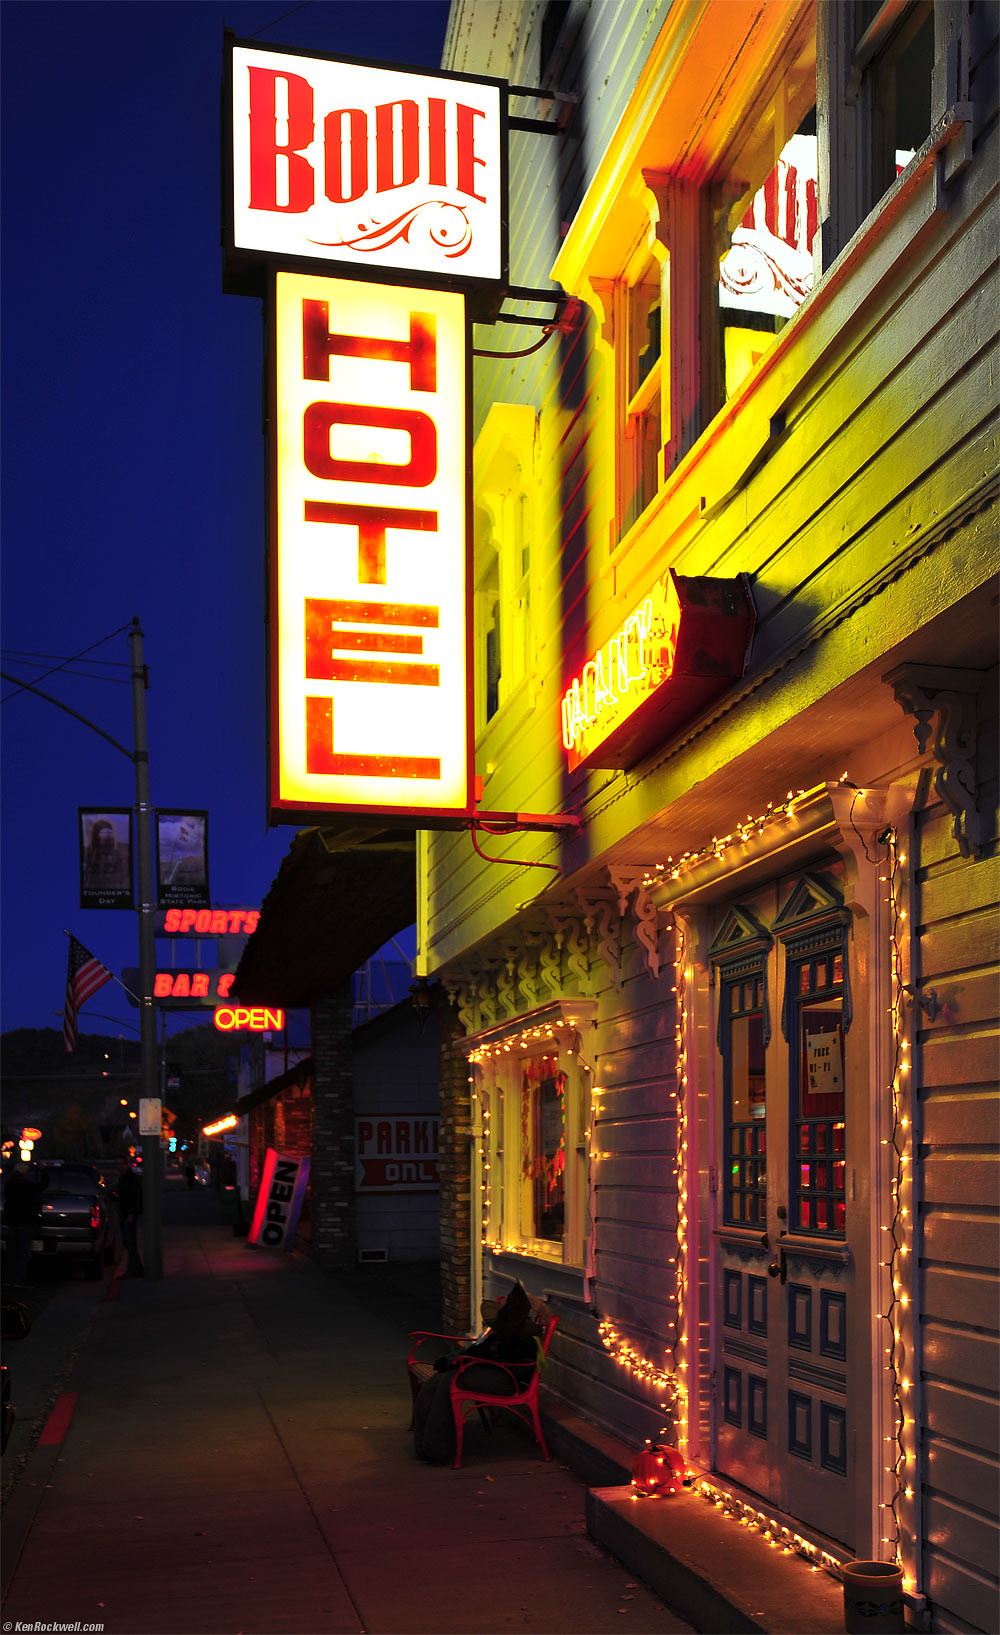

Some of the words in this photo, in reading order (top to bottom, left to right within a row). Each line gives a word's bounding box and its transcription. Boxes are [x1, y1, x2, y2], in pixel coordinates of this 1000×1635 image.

[302, 298, 442, 780] HOTEL
[164, 909, 261, 935] SPORTS
[154, 973, 210, 998] BAR
[214, 1007, 284, 1030] OPEN
[814, 1047, 830, 1058] FREE
[810, 1062, 830, 1072] WI-FI
[262, 1160, 299, 1246] OPEN
